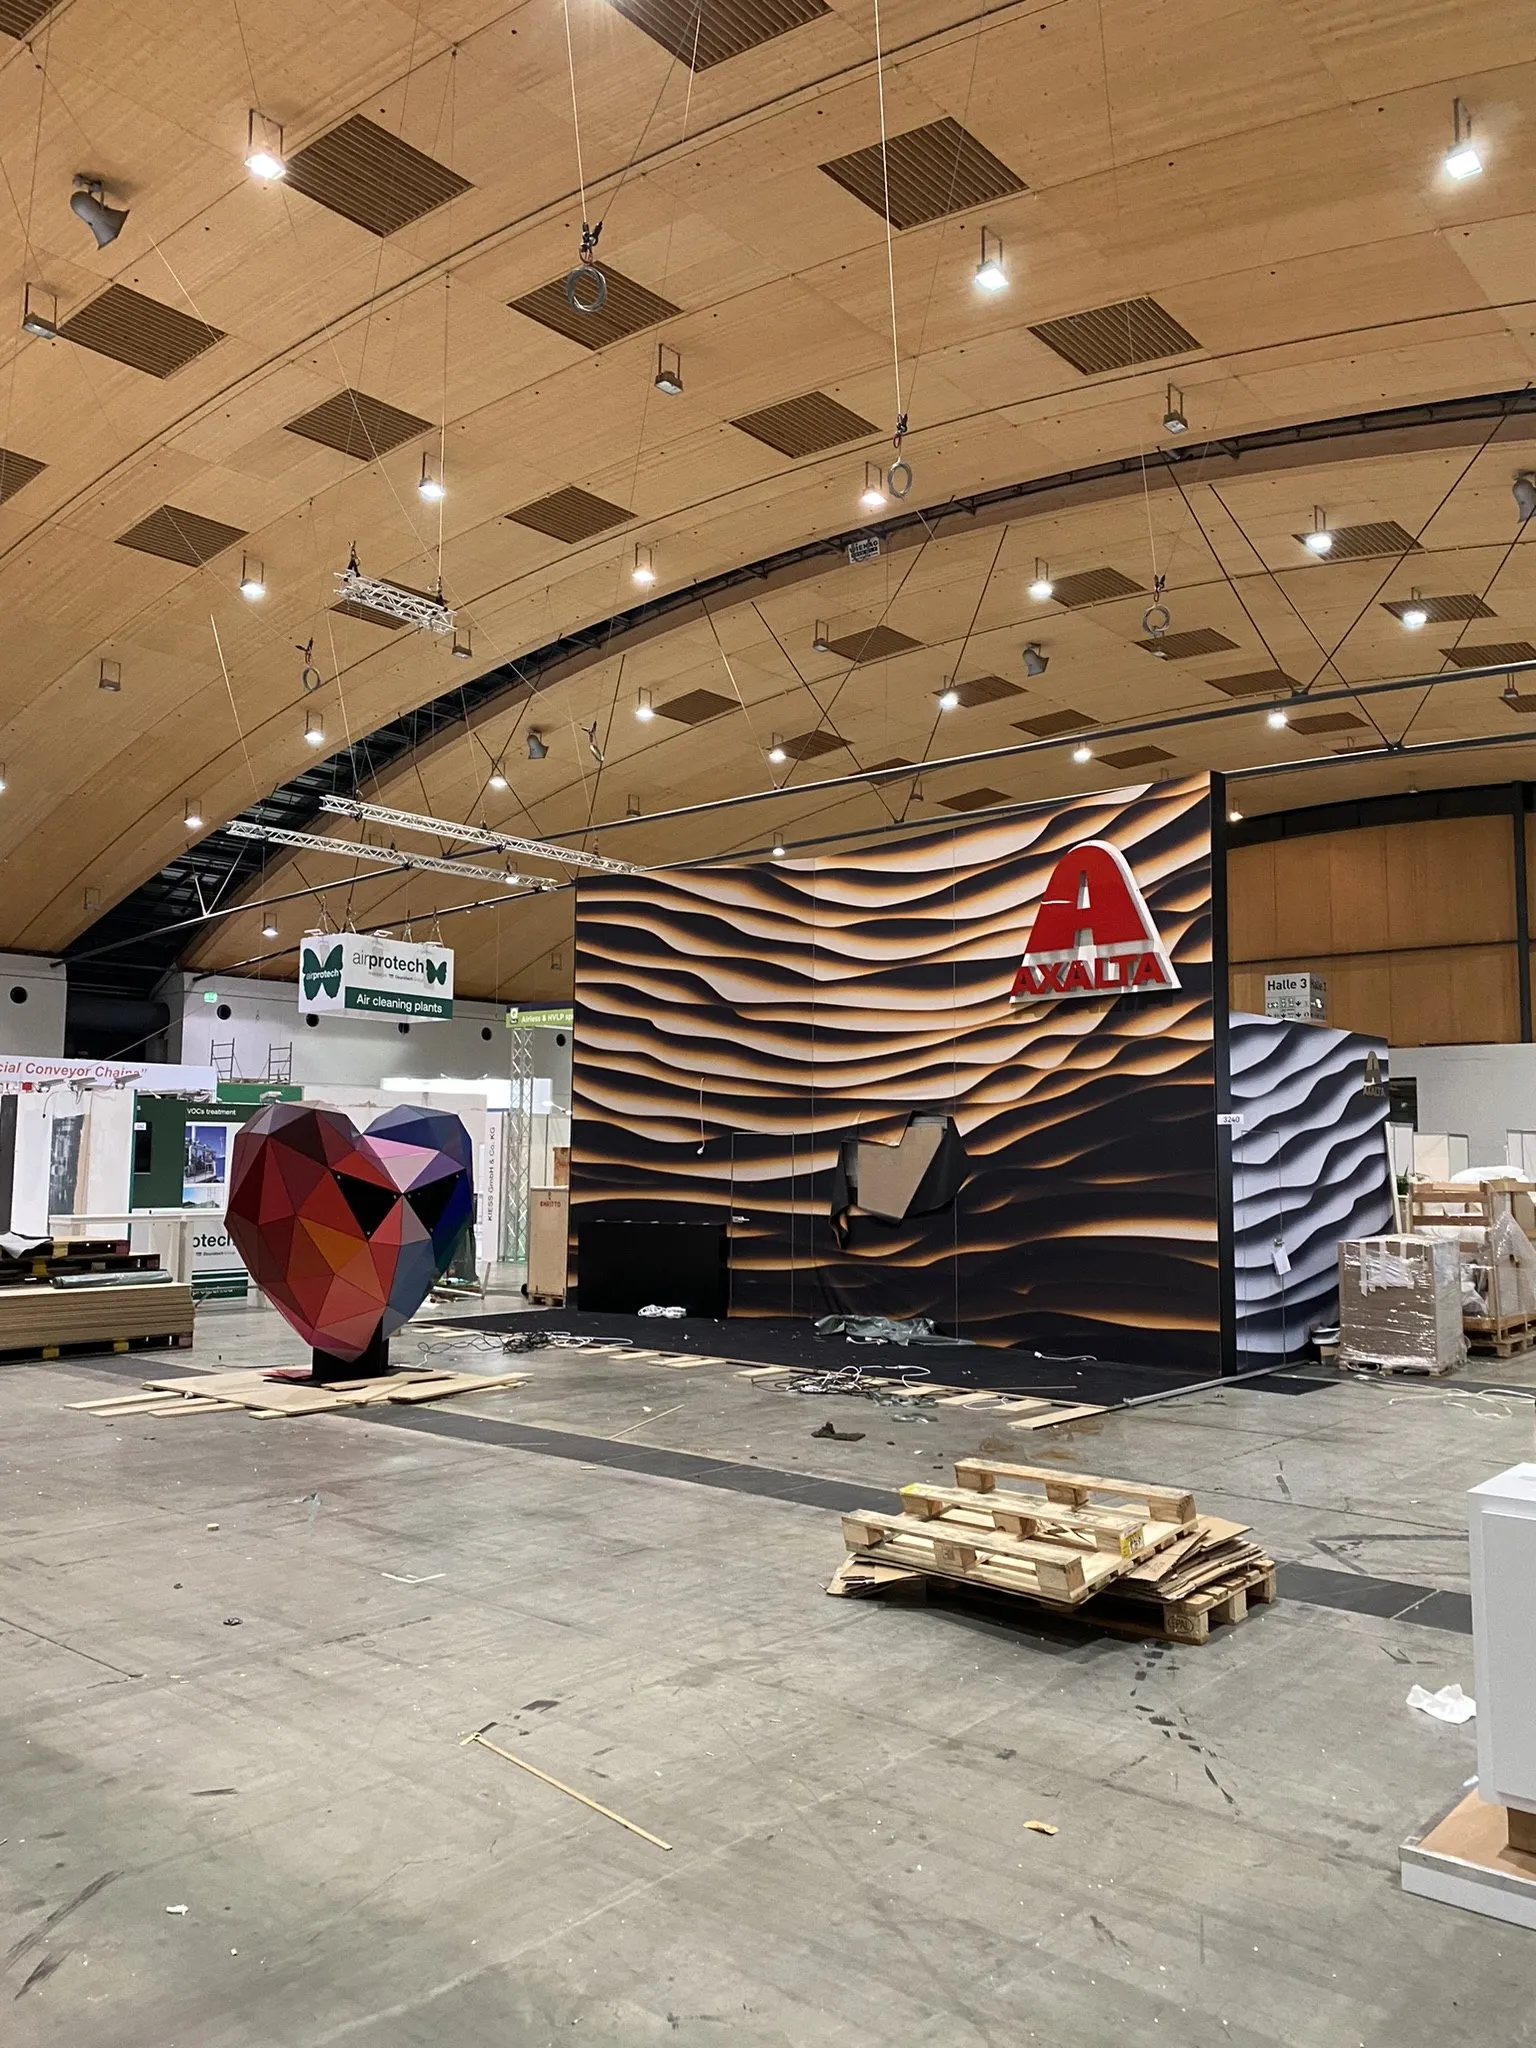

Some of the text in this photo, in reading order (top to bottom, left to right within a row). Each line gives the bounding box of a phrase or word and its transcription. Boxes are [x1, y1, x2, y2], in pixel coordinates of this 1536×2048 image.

[352, 949, 424, 973] airprotech
[305, 968, 339, 981] airprotech
[1010, 952, 1167, 997] AXALTA
[1267, 978, 1307, 990] Halle 3
[356, 994, 443, 1014] Air cleaning plants
[25, 1062, 91, 1079] Conveyor
[186, 1107, 236, 1116] VOCs treatment
[489, 1126, 496, 1140] KG
